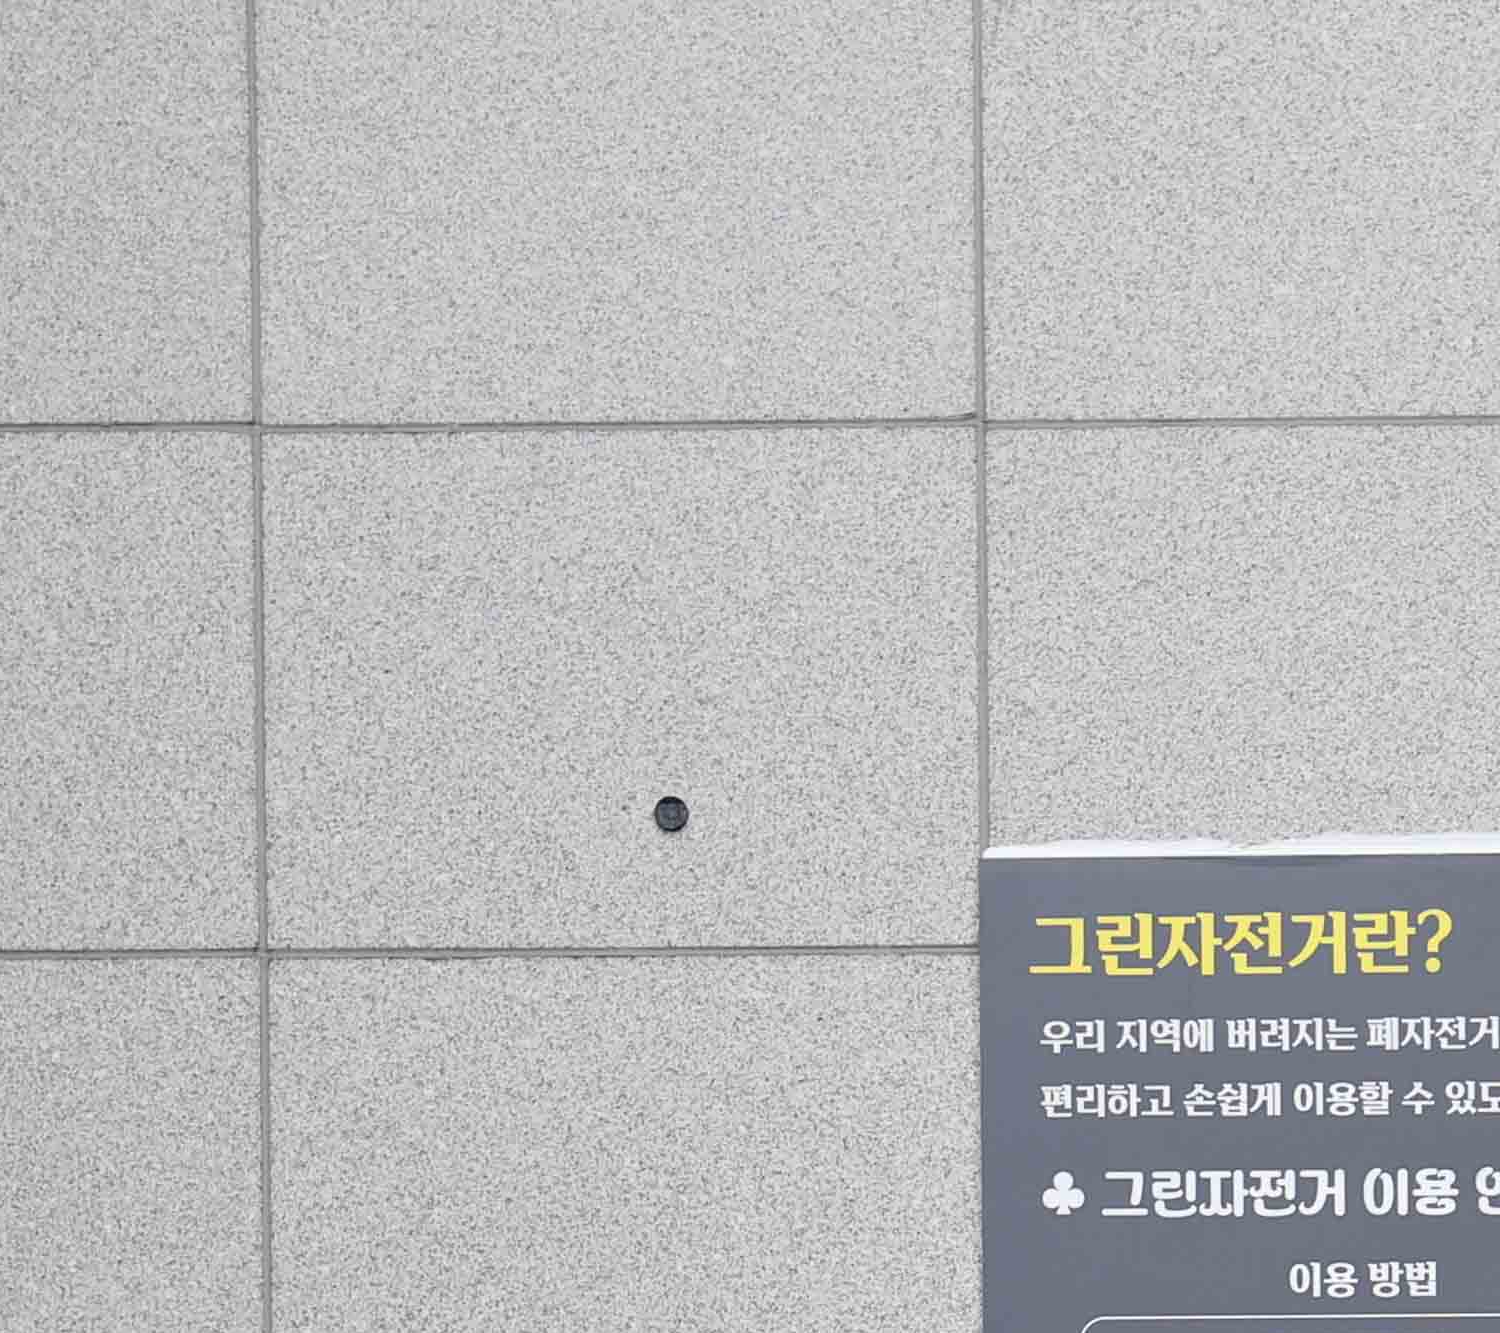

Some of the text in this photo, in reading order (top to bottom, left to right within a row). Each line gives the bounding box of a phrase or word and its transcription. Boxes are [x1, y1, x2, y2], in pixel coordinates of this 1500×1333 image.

[1029, 908, 1453, 976] 그린자전거란?
[1039, 1019, 1105, 1054] 우리
[1115, 1018, 1215, 1053] 지역에
[1225, 1017, 1359, 1052] 버려지는
[1040, 1083, 1175, 1118] 편리하고
[1182, 1081, 1282, 1117] 손쉽게
[1293, 1081, 1394, 1117] 이용할
[1401, 1081, 1436, 1115] 수
[1101, 1168, 1346, 1218] 그린자전거
[1363, 1167, 1460, 1216] 이용
[1289, 1261, 1437, 1298] 이용 방법
